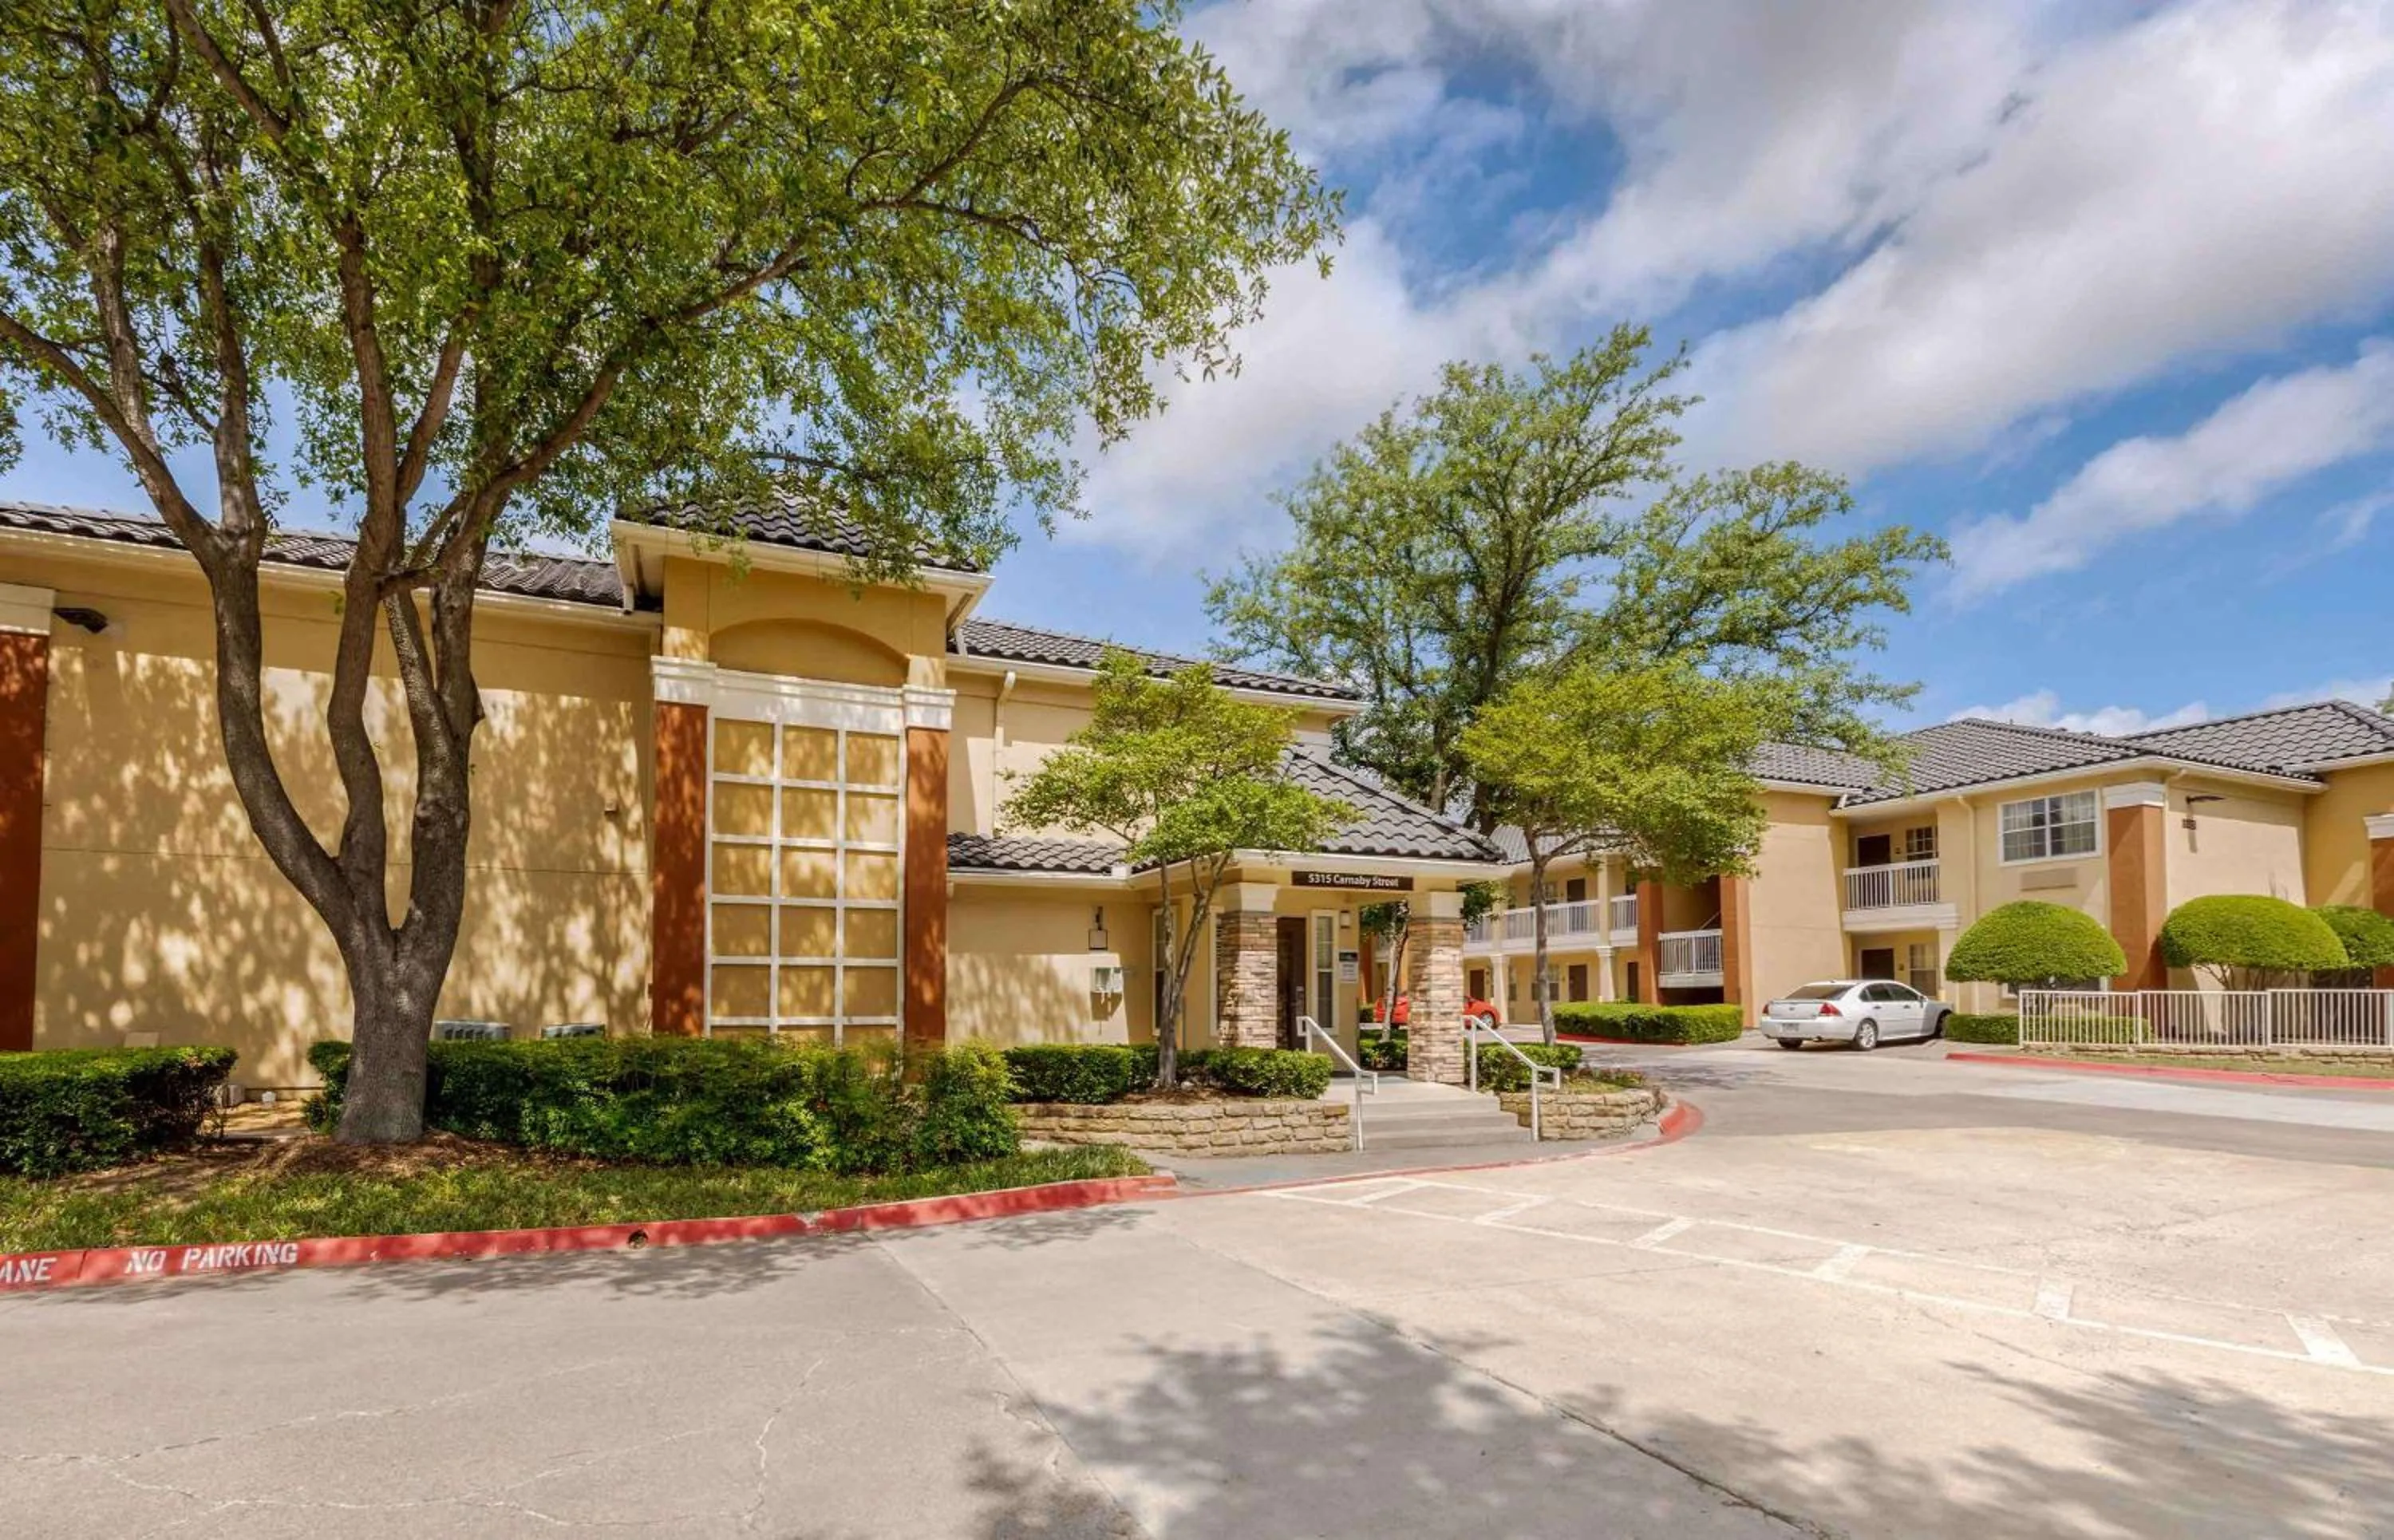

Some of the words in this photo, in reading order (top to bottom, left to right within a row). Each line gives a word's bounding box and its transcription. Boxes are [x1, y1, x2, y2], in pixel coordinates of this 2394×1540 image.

[1308, 874, 1332, 884] 5315
[1333, 874, 1372, 887] Carnaby
[1372, 875, 1399, 887] Street
[124, 1250, 167, 1274] NO
[180, 1242, 299, 1270] PARKING
